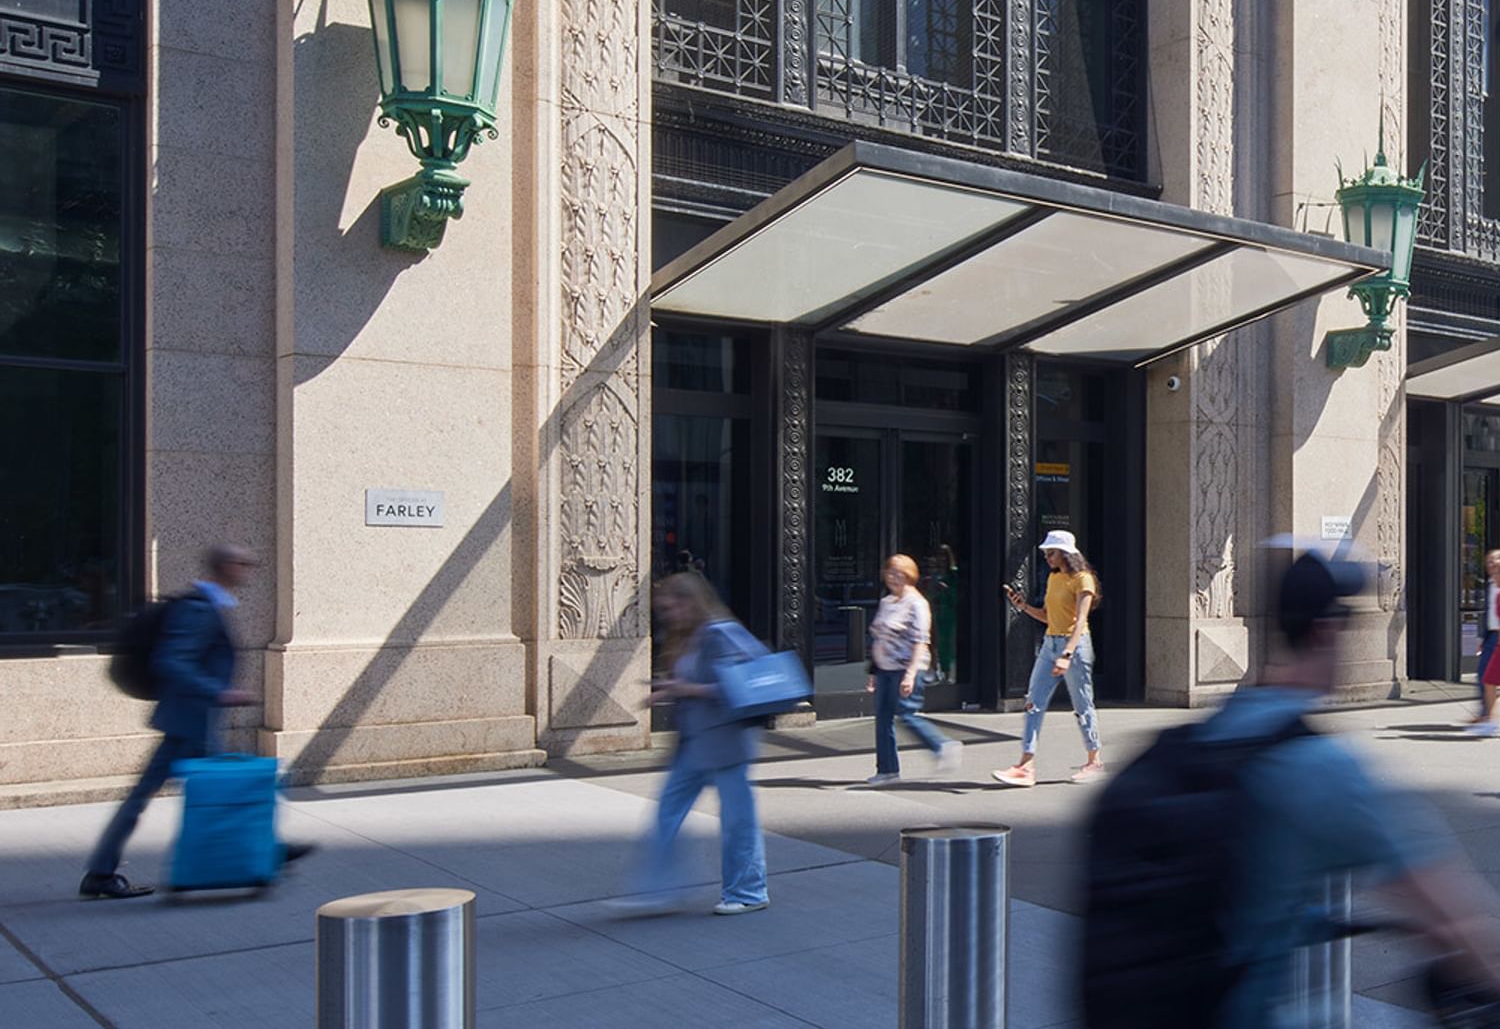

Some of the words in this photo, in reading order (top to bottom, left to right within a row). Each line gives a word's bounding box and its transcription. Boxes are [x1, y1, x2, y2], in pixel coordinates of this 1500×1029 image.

[827, 466, 854, 483] 382
[834, 484, 859, 492] Avenue
[376, 504, 435, 517] FARLEY
